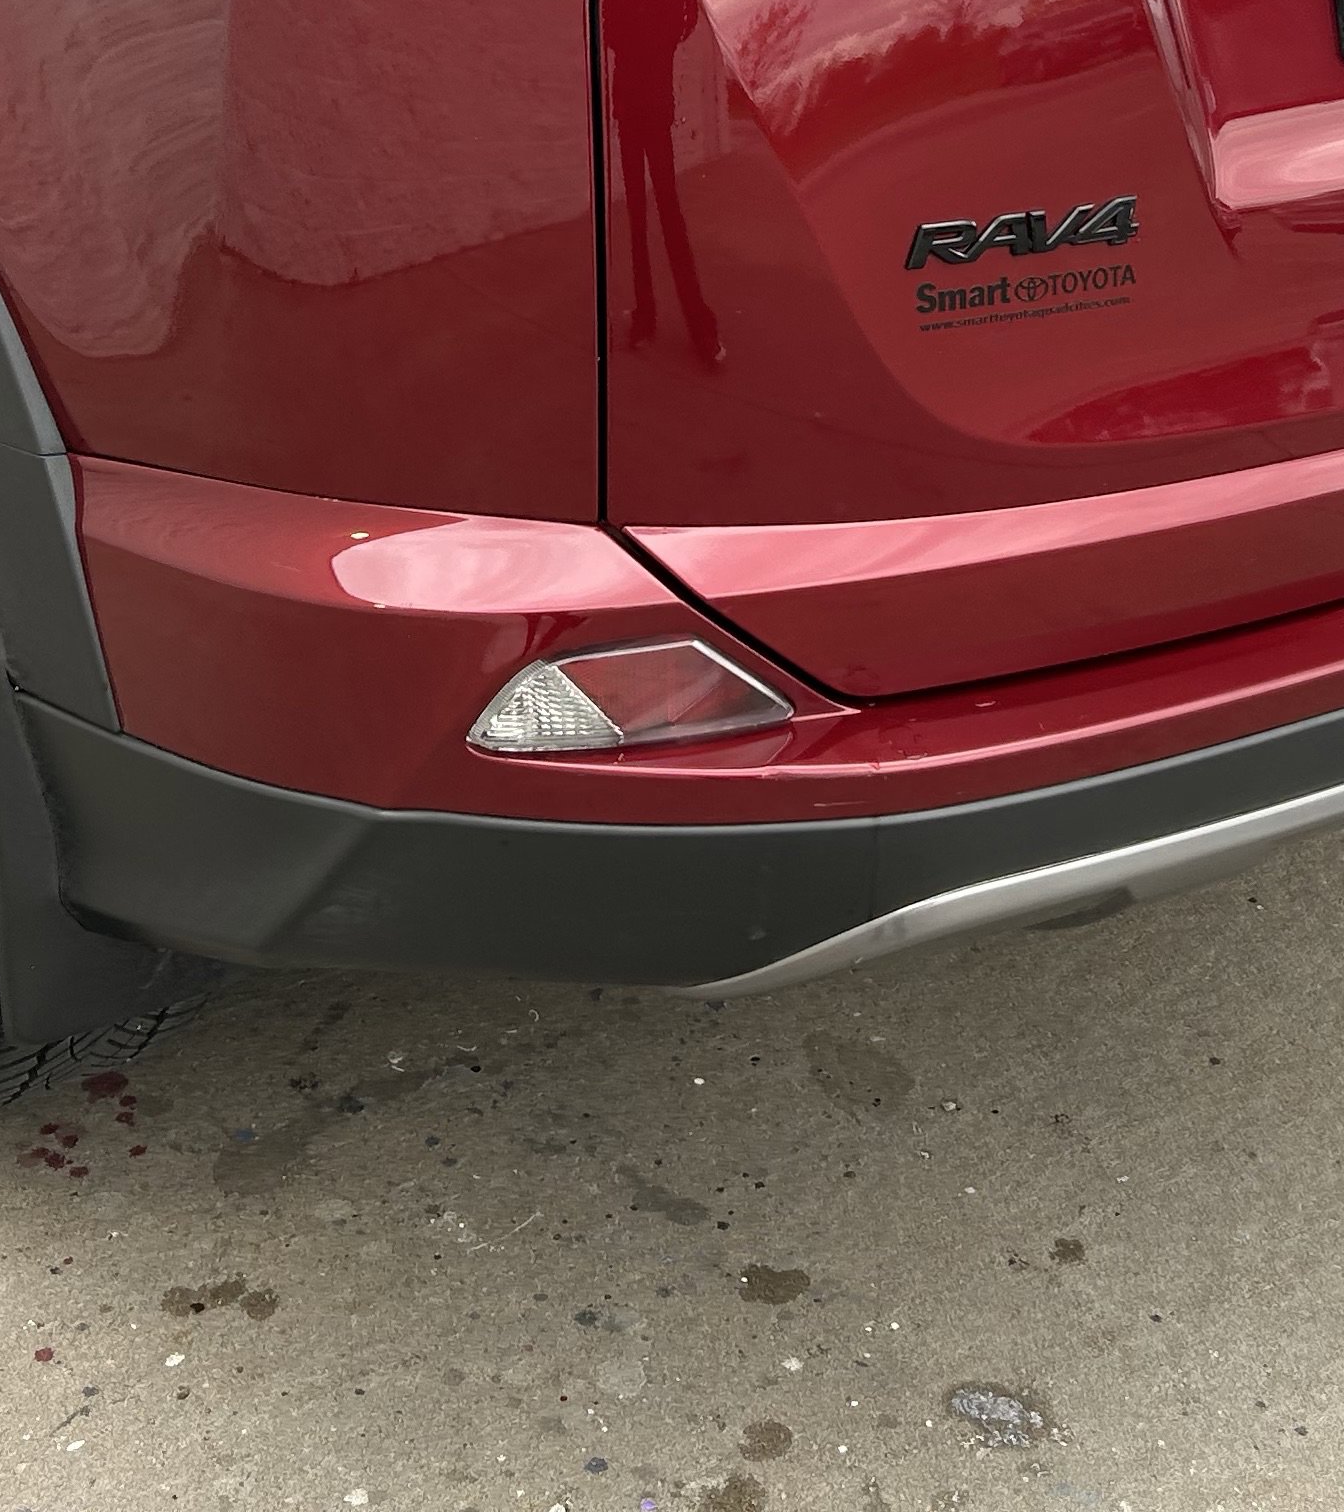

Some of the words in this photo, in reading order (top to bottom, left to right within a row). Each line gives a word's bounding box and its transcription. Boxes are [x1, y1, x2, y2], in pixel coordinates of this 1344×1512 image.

[905, 194, 1140, 270] RAV4
[916, 276, 1010, 314] Smart
[1048, 264, 1137, 296] TOYOTA
